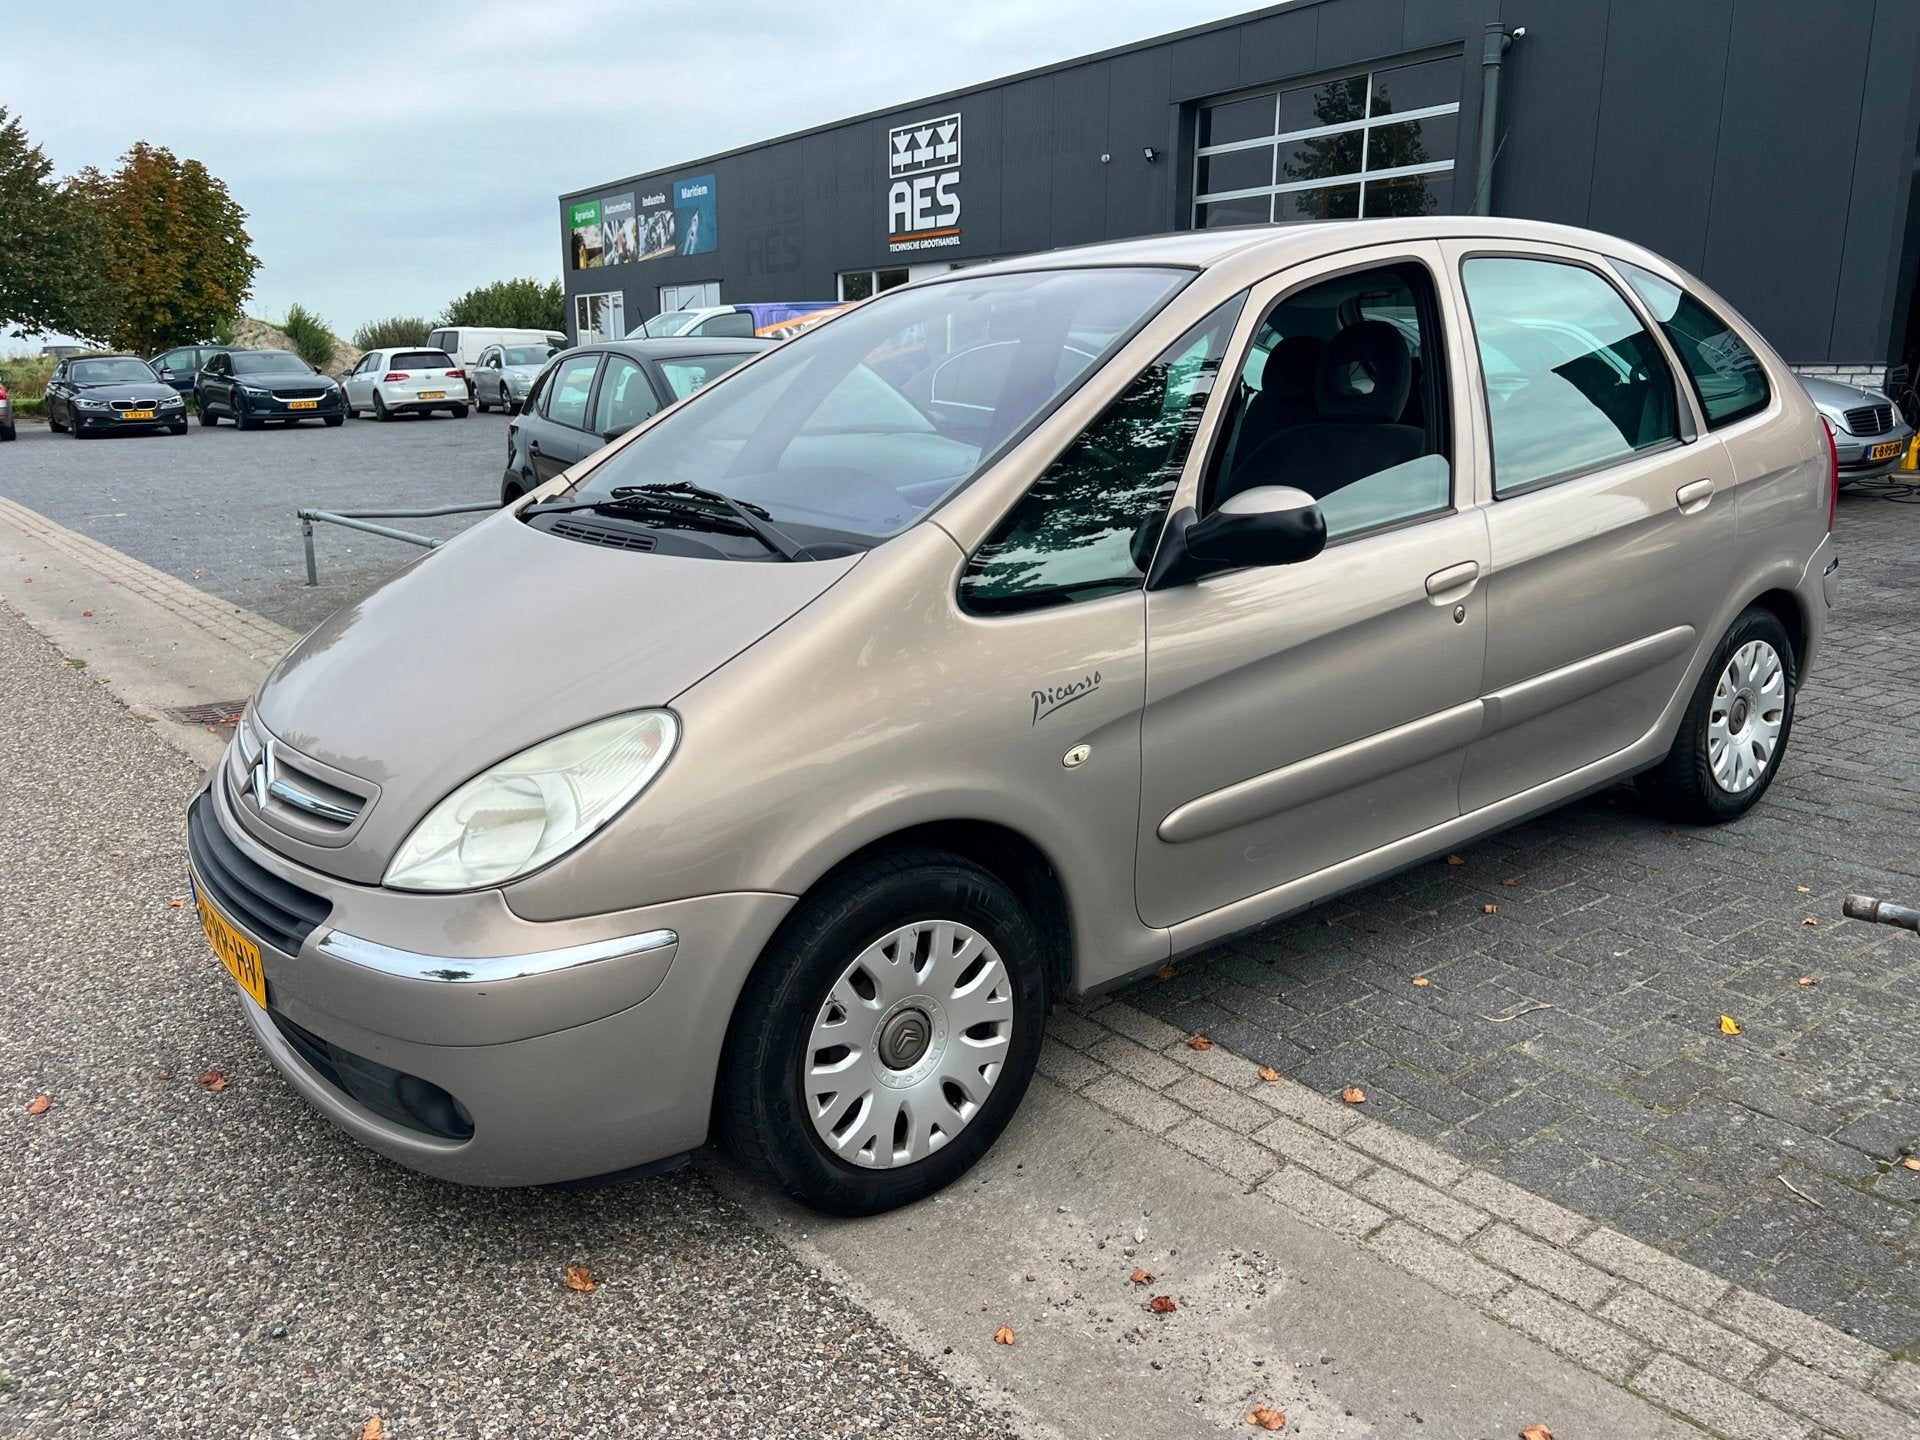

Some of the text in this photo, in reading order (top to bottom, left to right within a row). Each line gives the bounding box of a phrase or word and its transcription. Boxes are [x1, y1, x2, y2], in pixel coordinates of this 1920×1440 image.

[681, 184, 708, 199] Maritiem
[642, 192, 666, 207] Industrie
[888, 171, 961, 234] AES
[574, 208, 596, 223] Agrarisch
[889, 236, 961, 252] TECHNISCHE GROOTHANDEL
[1031, 671, 1101, 728] Picasso
